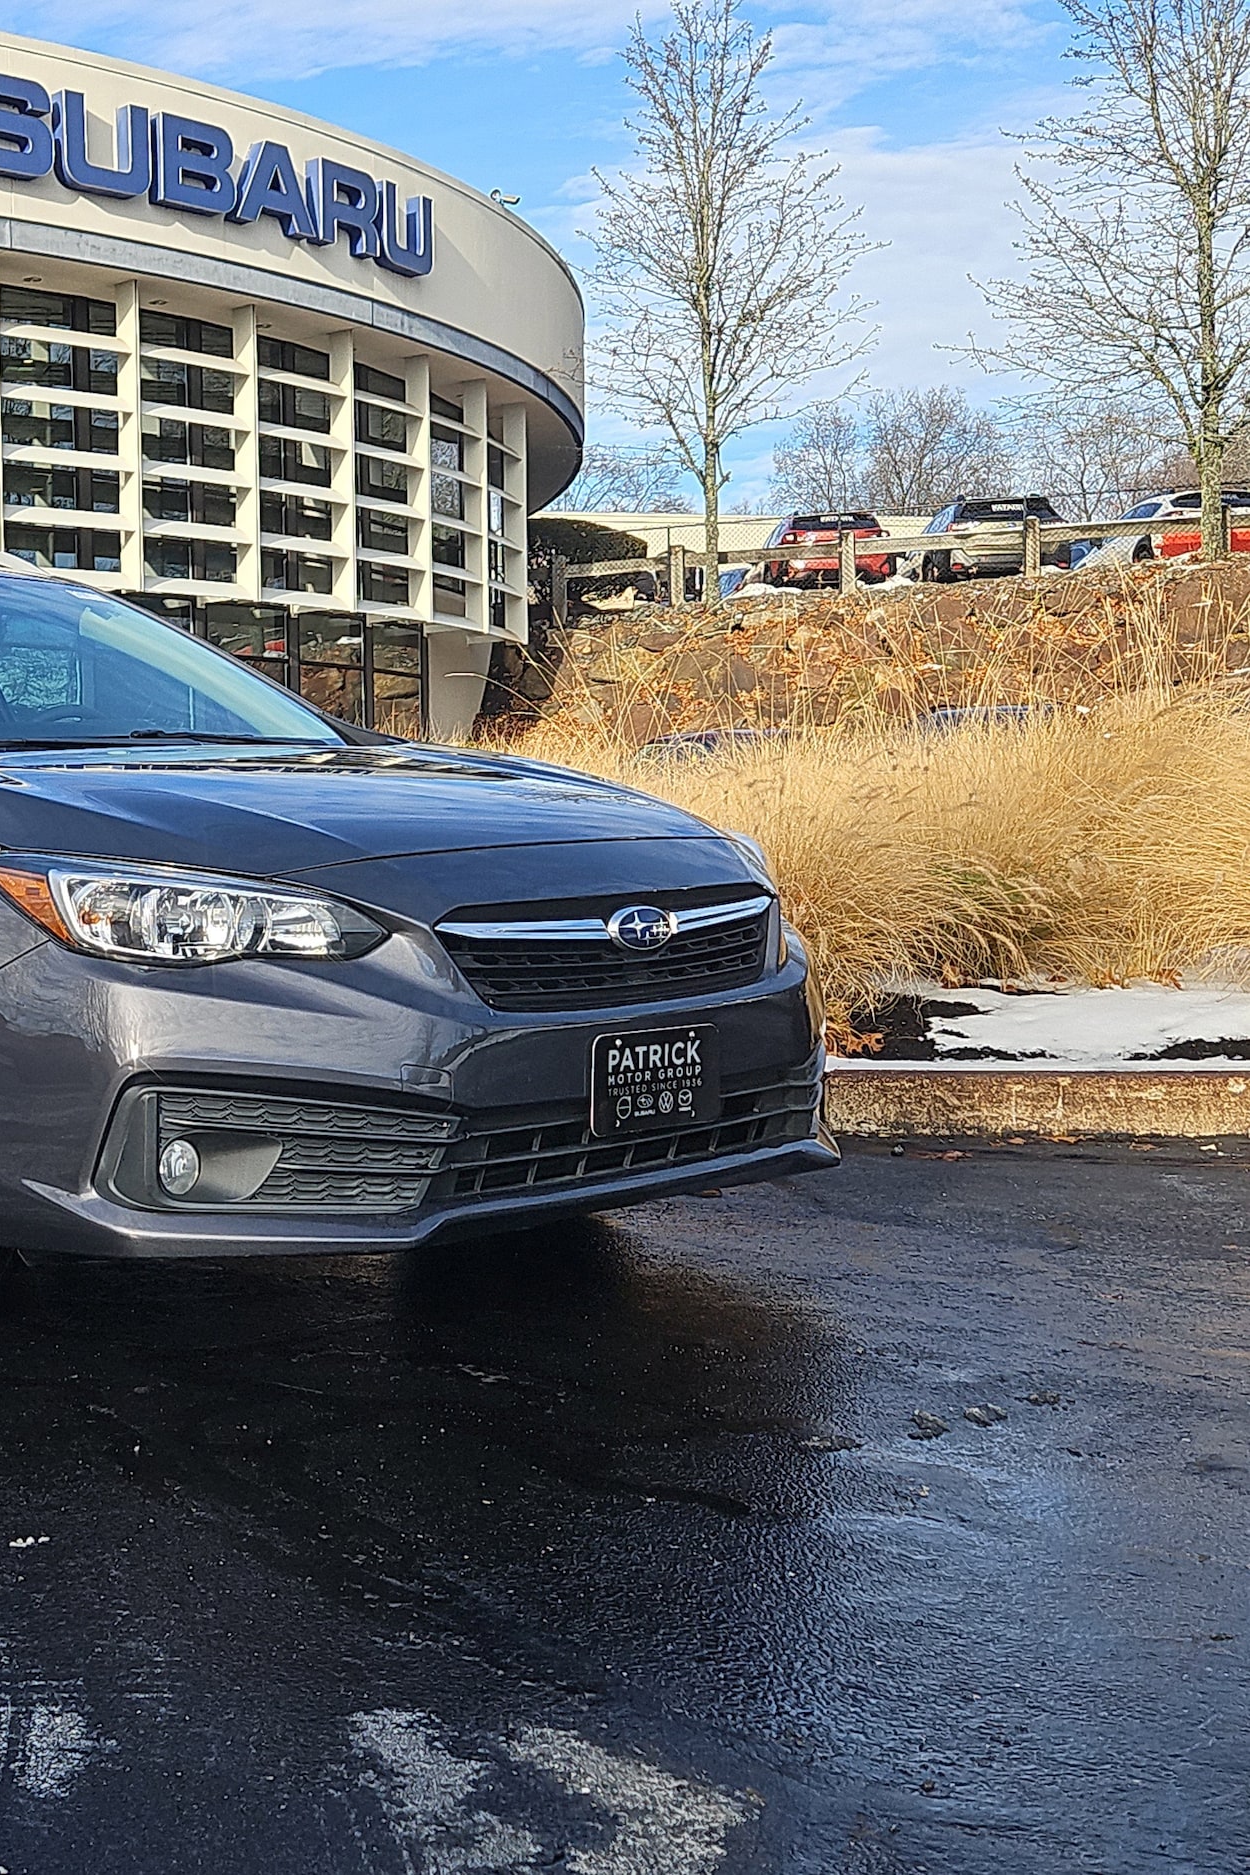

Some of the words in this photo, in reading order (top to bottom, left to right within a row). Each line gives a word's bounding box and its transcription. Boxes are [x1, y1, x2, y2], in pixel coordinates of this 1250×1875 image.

[608, 1040, 701, 1073] PATRICK
[608, 1070, 651, 1086] MOTOR
[658, 1065, 701, 1080] GROUP
[608, 1084, 647, 1097] TRUSTED
[651, 1080, 677, 1092] SINCE
